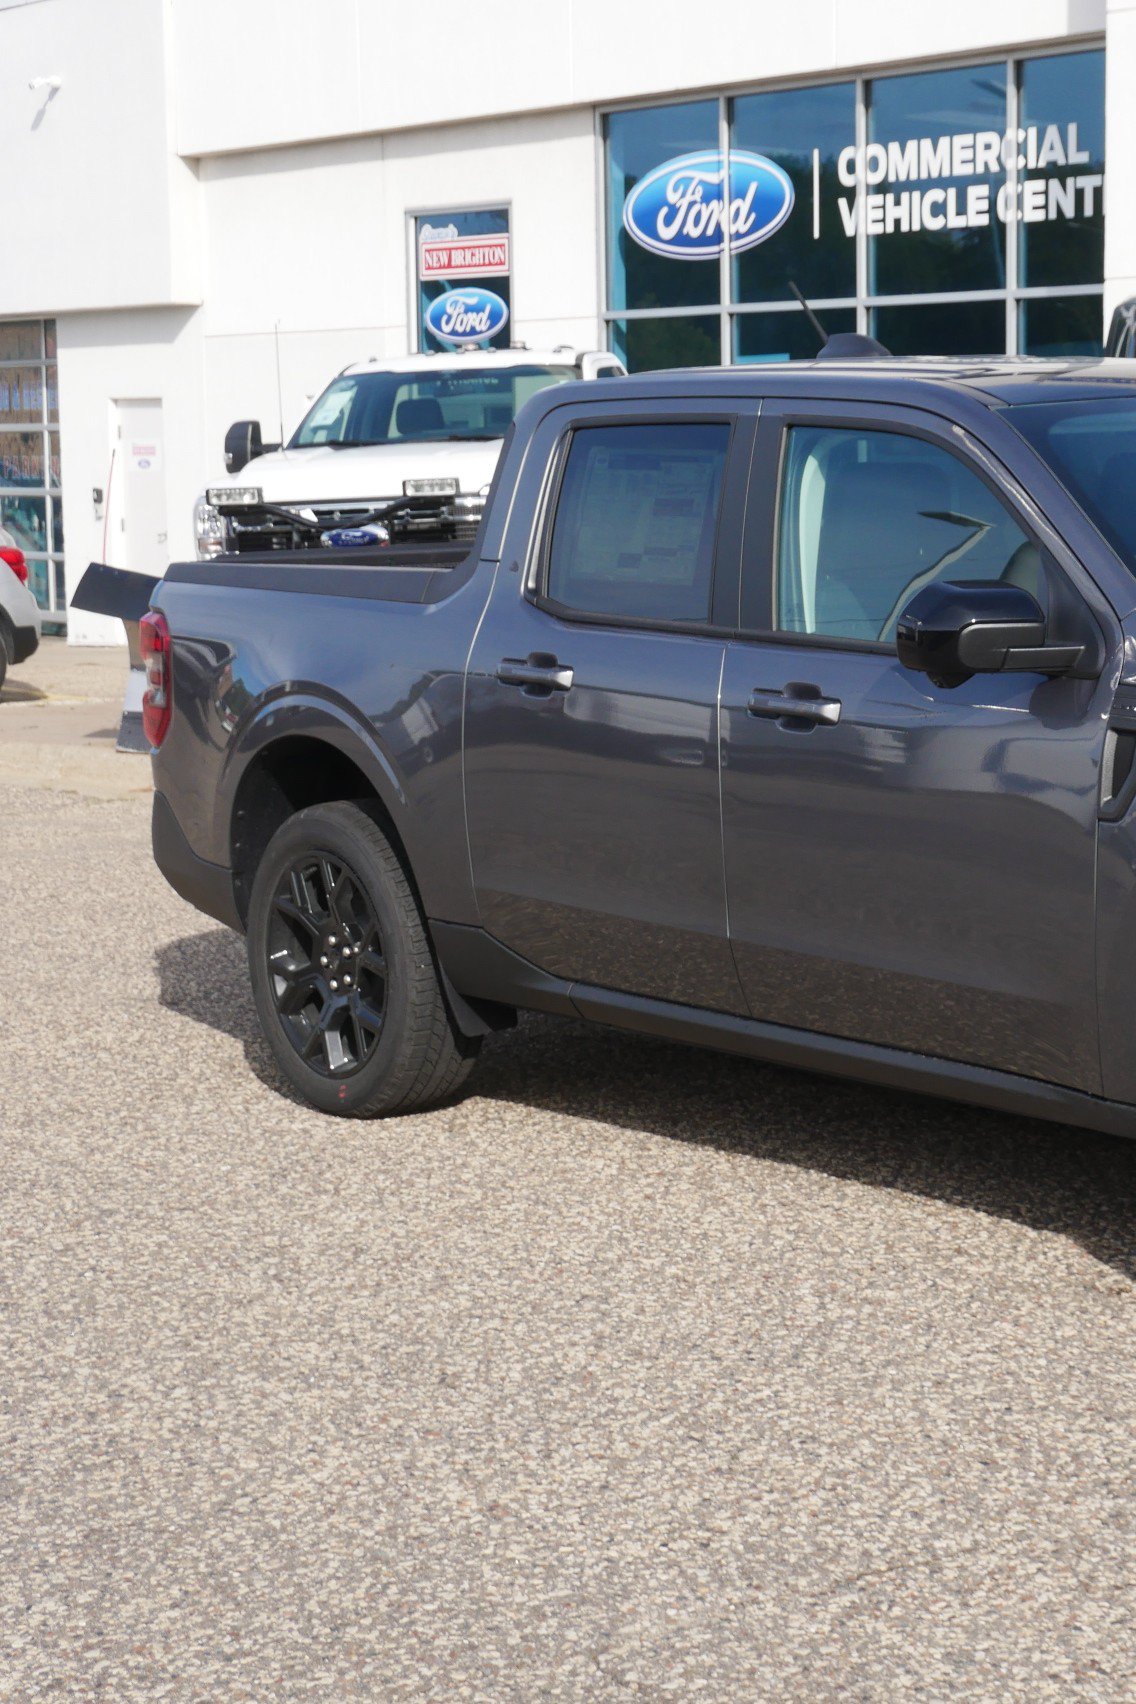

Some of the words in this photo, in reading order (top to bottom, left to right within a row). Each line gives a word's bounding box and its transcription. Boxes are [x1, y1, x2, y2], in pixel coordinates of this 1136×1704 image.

[837, 122, 1090, 187] COMMERCIAL
[656, 171, 758, 239] Ford
[837, 183, 989, 238] VEHICLE
[996, 174, 1105, 224] CENT
[426, 250, 450, 268] NEW
[451, 245, 505, 268] BRIGHTON
[441, 296, 491, 333] Ford
